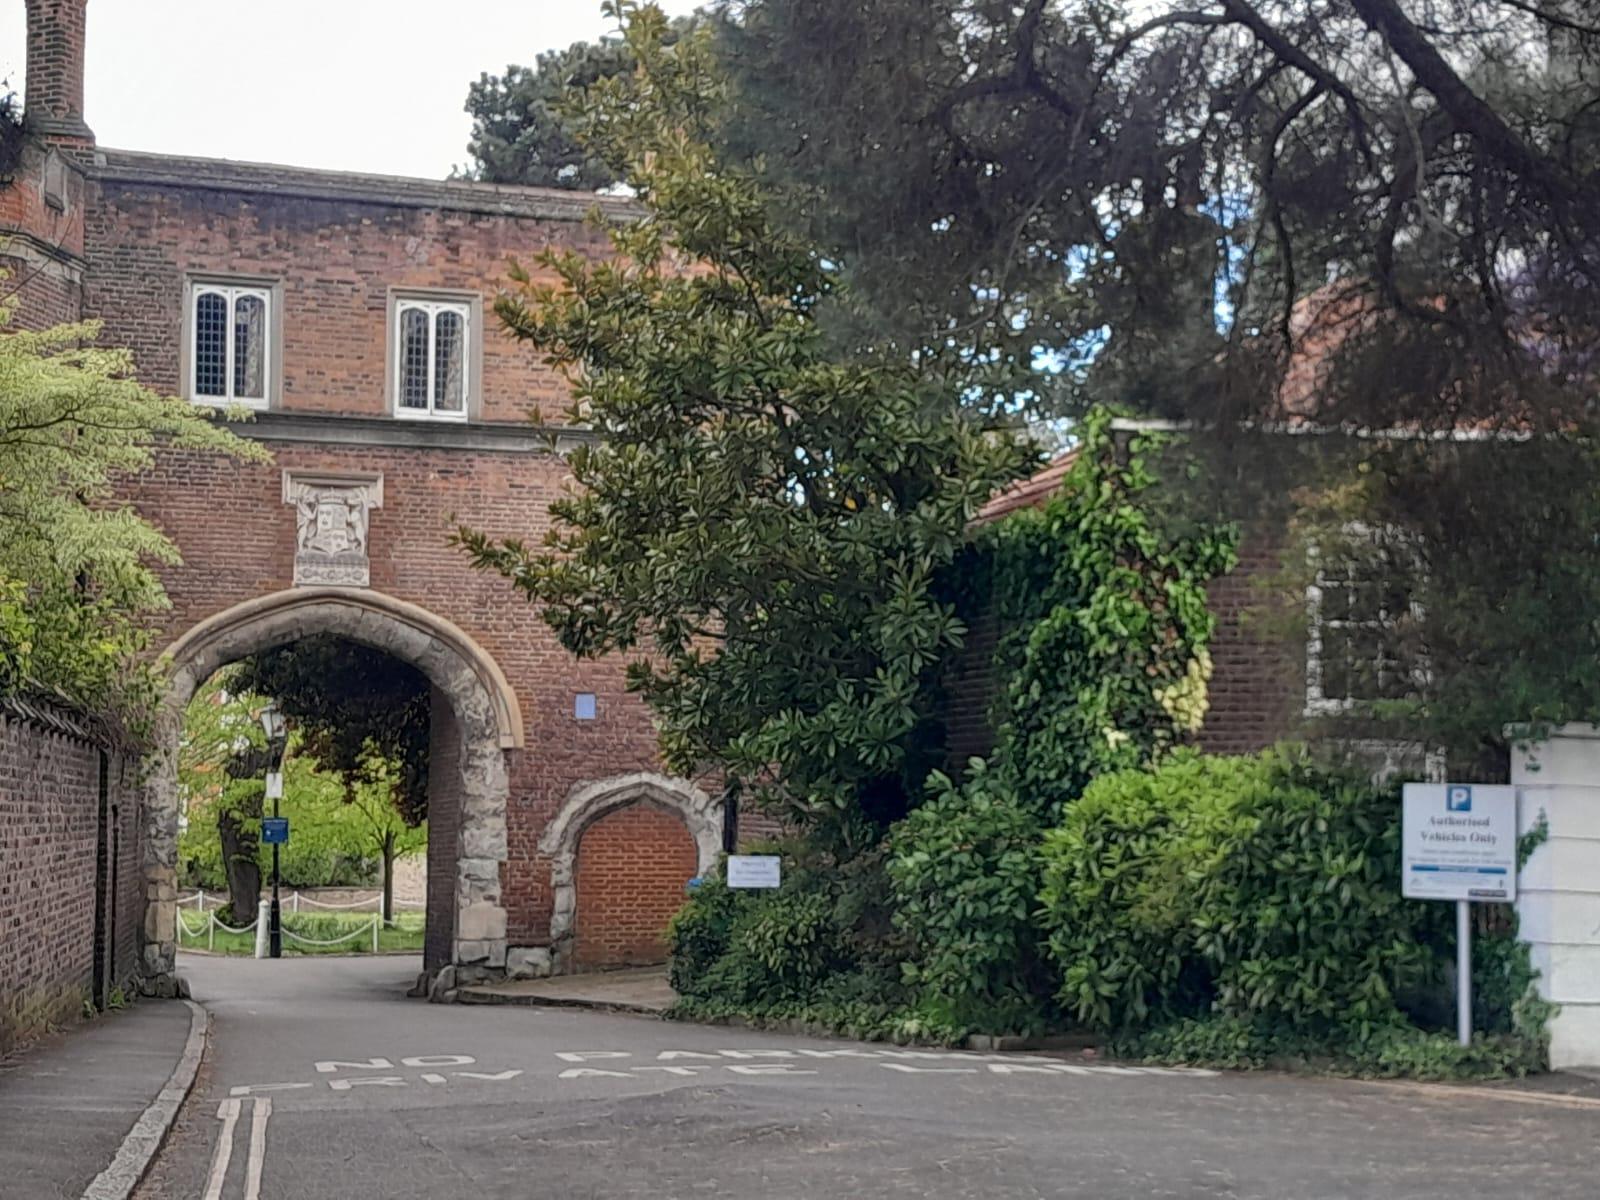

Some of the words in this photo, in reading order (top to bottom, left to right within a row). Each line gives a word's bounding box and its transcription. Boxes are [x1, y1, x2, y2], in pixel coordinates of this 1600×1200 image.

[1451, 788, 1467, 809] P
[1421, 831, 1466, 843] Vehicles
[1470, 832, 1497, 845] Only
[314, 1054, 477, 1073] NO
[554, 1048, 1067, 1063] PARKING
[230, 1064, 818, 1096] PRIVATE
